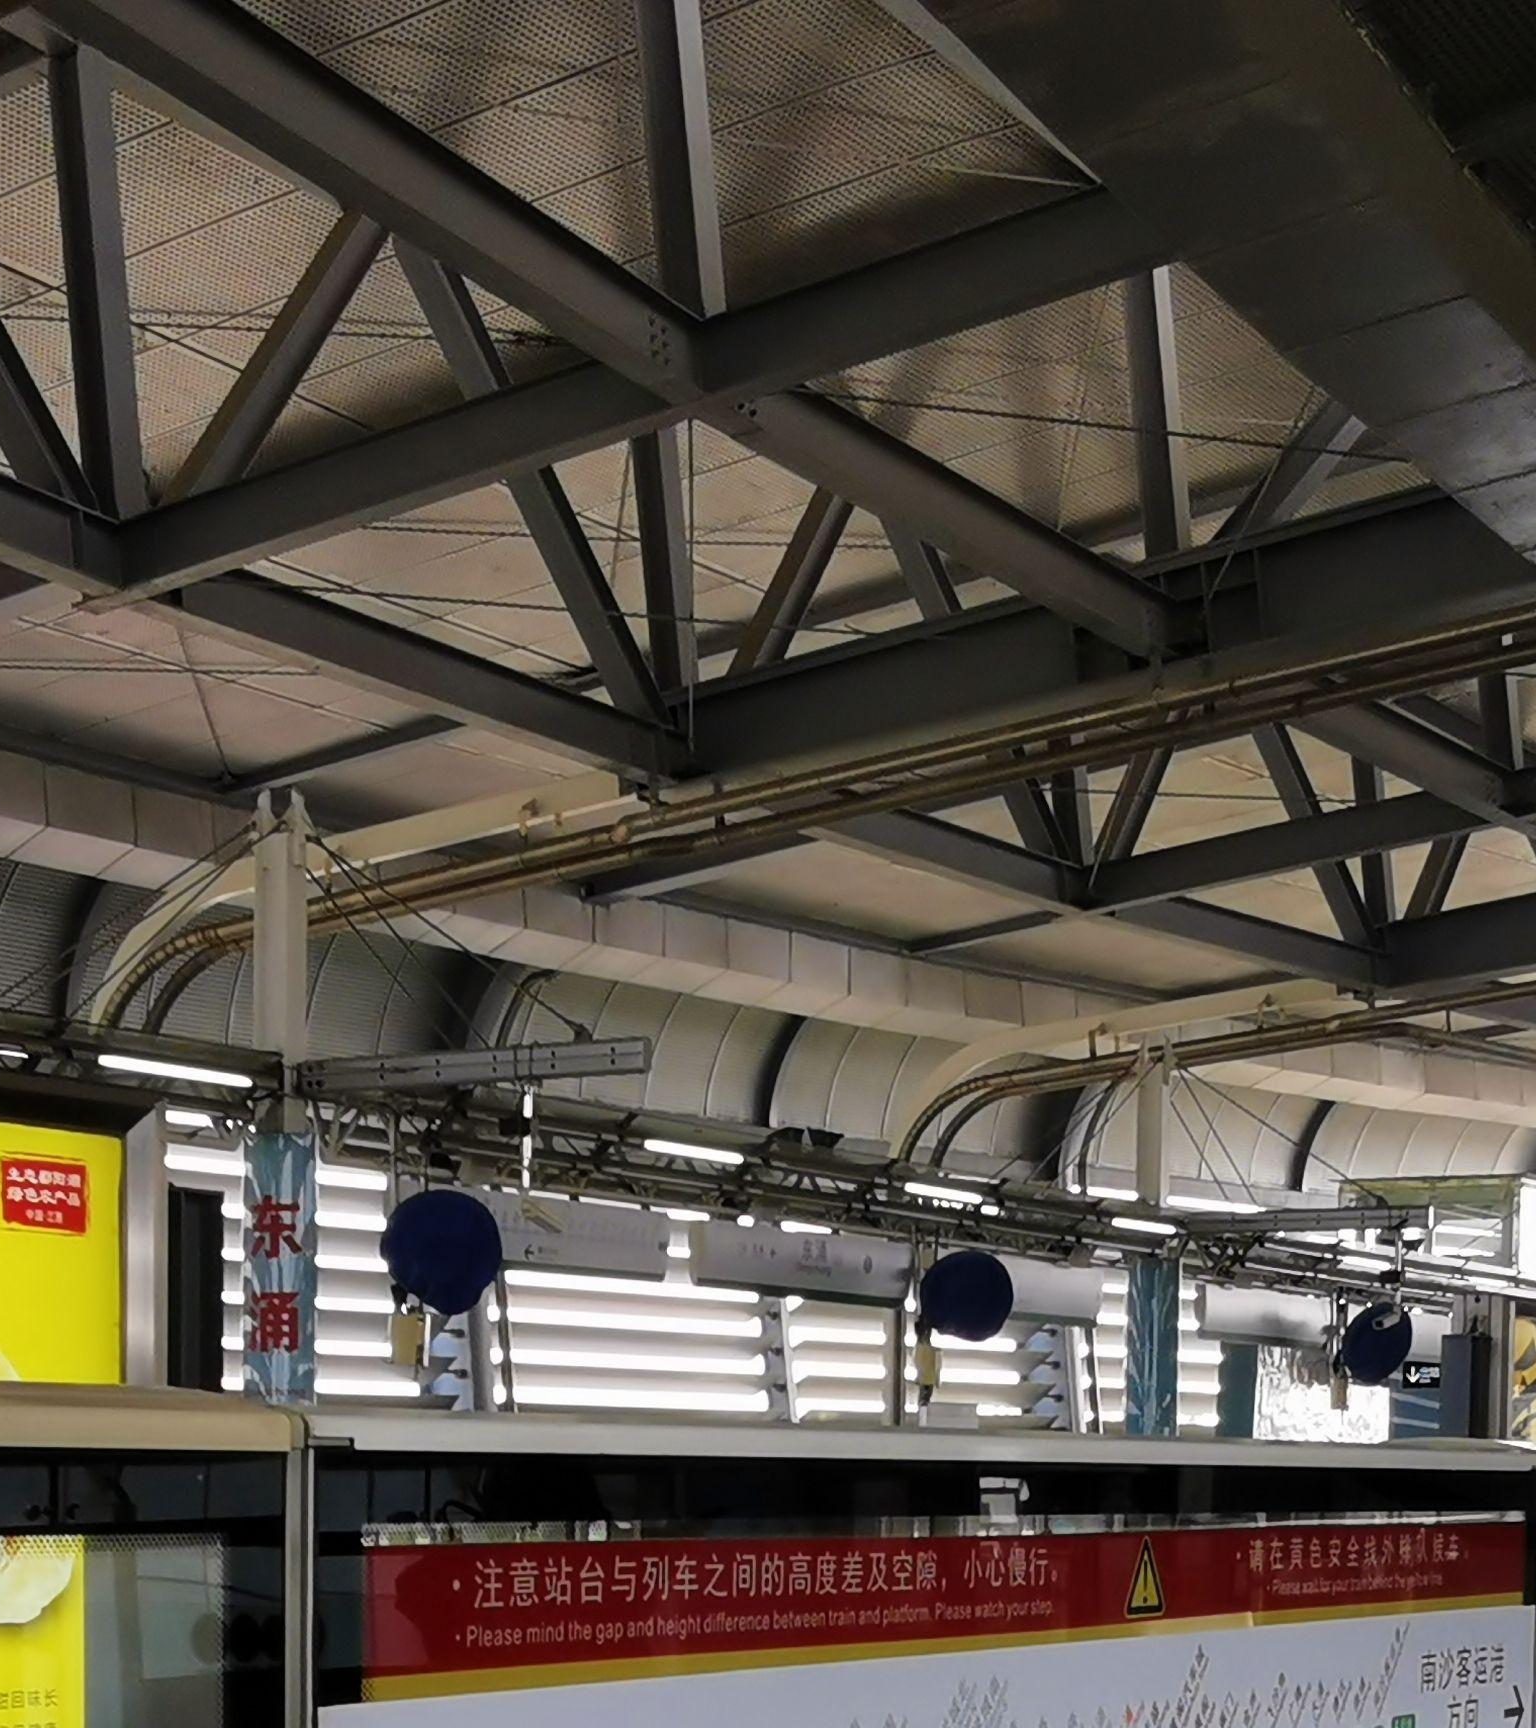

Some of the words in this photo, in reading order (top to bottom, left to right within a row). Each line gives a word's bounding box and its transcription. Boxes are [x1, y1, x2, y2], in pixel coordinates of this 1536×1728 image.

[247, 1194, 302, 1353] 东涌
[466, 1624, 522, 1648] Please
[526, 1621, 564, 1645] mind
[568, 1620, 593, 1641] the
[595, 1623, 623, 1645] gap
[627, 1616, 654, 1638] and
[656, 1613, 702, 1640] height
[703, 1611, 770, 1634] difference
[773, 1608, 826, 1630] between
[829, 1605, 856, 1627] train
[859, 1605, 881, 1626] and
[934, 1602, 972, 1621] Please
[974, 1600, 1004, 1619] watch
[1005, 1600, 1029, 1621] your
